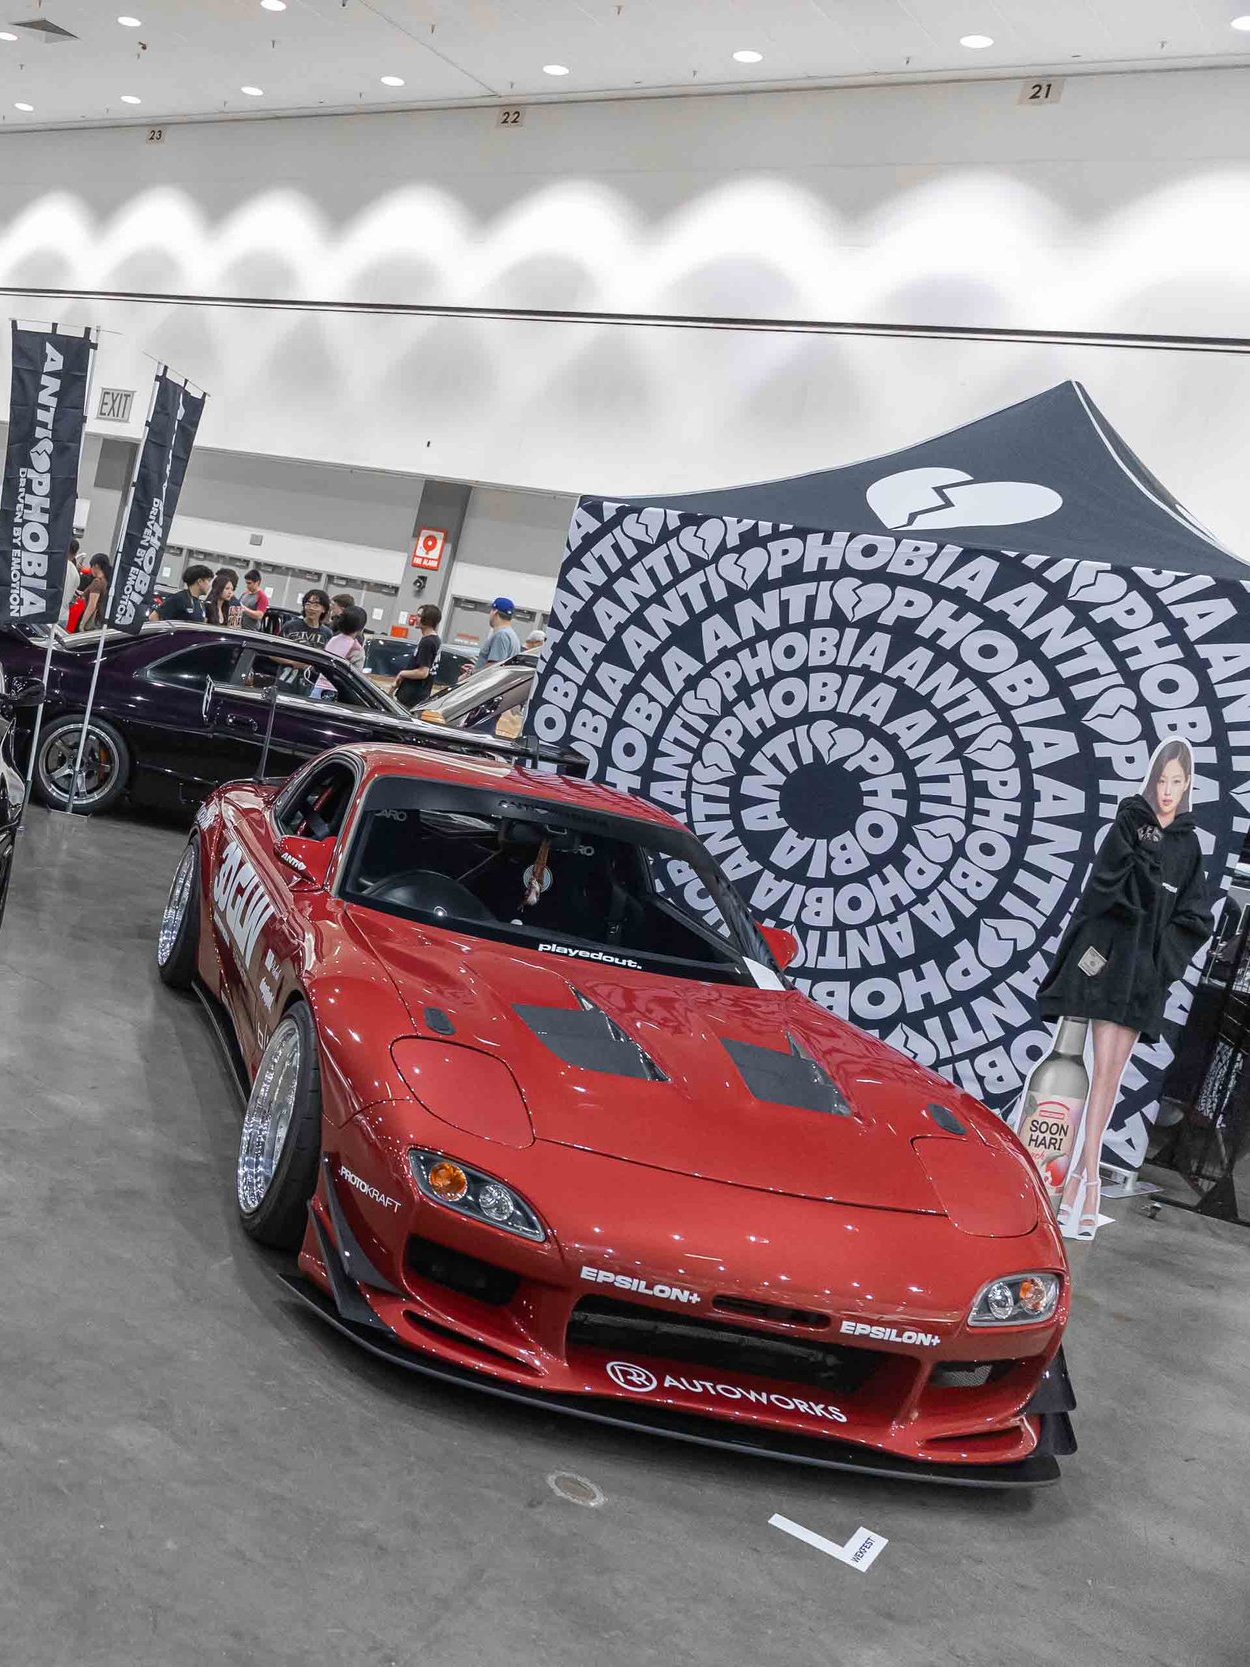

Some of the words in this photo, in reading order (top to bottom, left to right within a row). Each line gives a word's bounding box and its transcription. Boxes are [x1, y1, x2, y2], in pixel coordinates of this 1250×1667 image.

[1029, 83, 1052, 100] 21
[500, 110, 521, 125] 22
[149, 129, 163, 141] 23
[100, 391, 131, 419] EXIT
[14, 468, 28, 523] DRIVEN
[140, 497, 161, 547] DRIVEN
[12, 526, 23, 547] BY
[134, 547, 147, 567] BY
[9, 549, 22, 618] EMOTION
[114, 566, 140, 624] EMOTION
[538, 941, 643, 970] playedout.
[1027, 1133, 1064, 1152] HARI
[1029, 1119, 1069, 1138] SOON
[339, 1164, 402, 1213] PROTOKRAFT
[580, 1265, 701, 1305] EPSILON+
[839, 1320, 942, 1347] EPSILON+
[663, 1374, 848, 1424] AUTOWORKS
